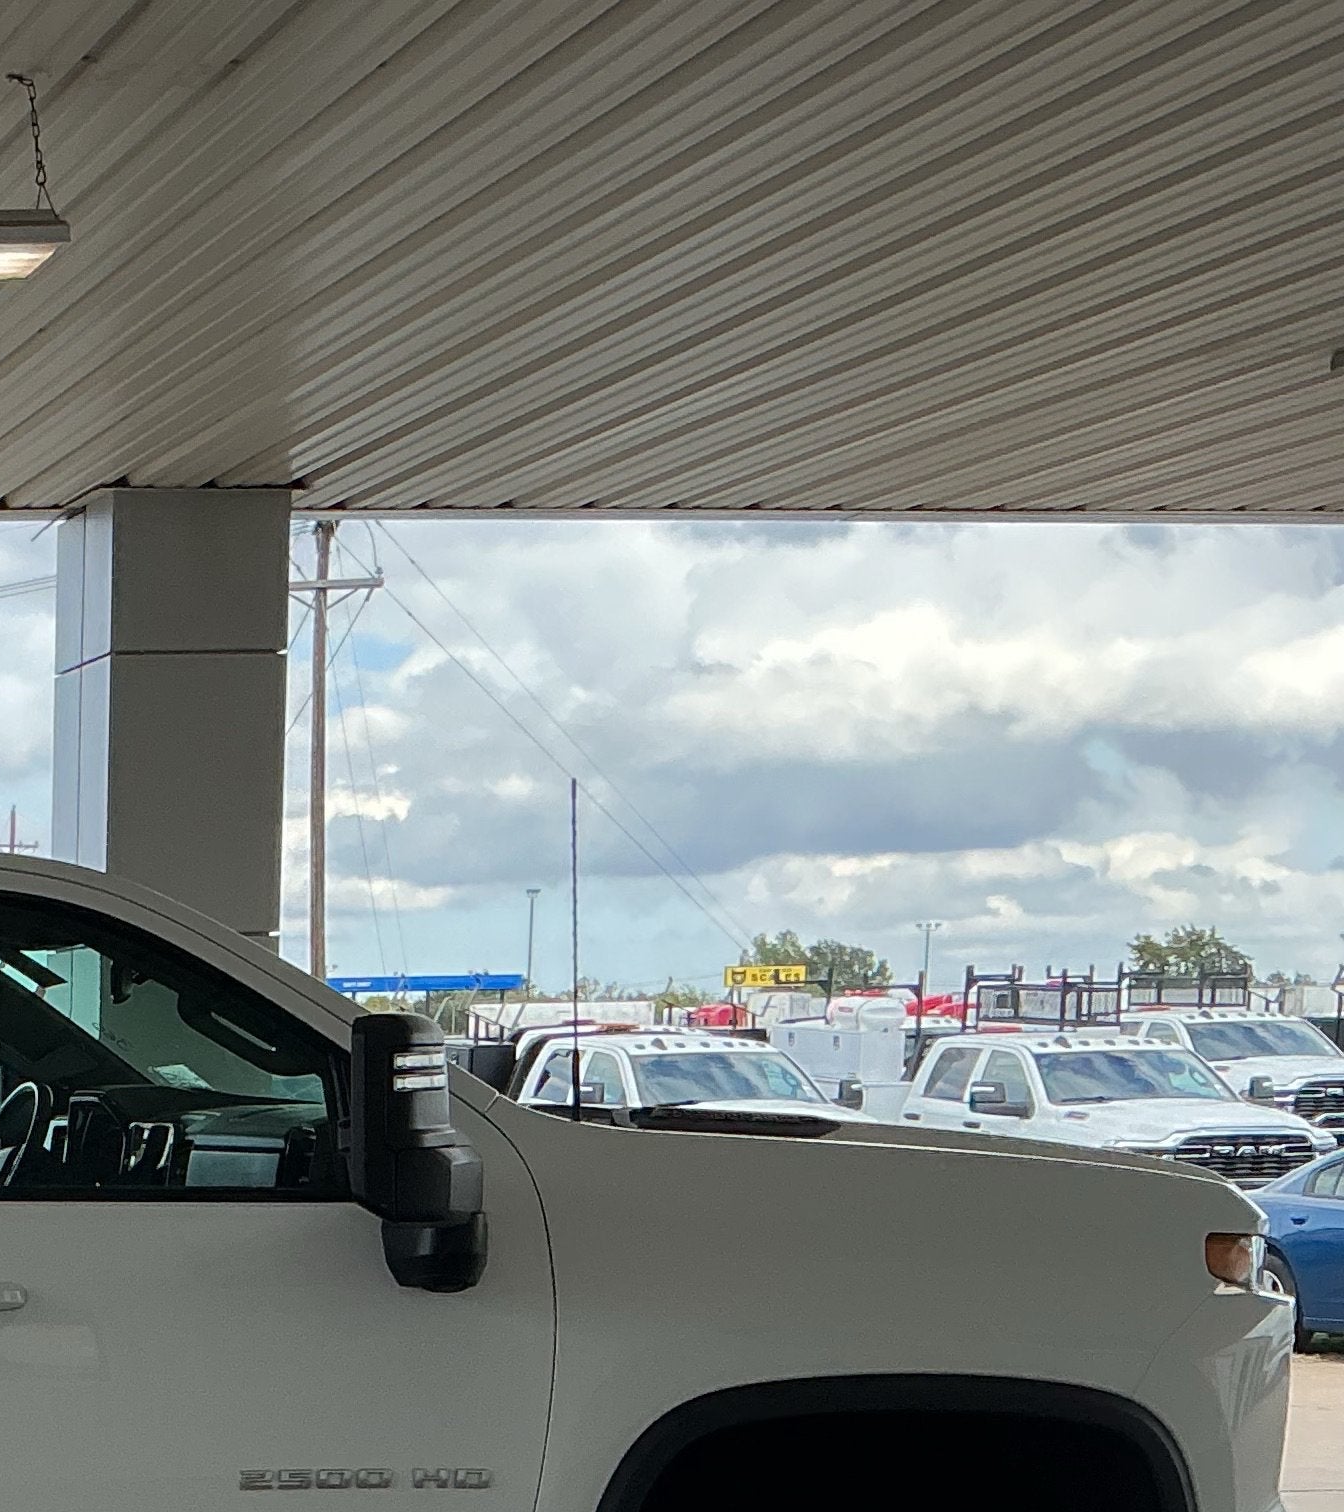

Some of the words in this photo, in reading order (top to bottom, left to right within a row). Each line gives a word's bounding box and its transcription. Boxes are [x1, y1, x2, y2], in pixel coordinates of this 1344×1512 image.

[751, 973, 801, 983] SCES
[239, 1468, 393, 1490] 2500
[413, 1467, 493, 1489] HD
